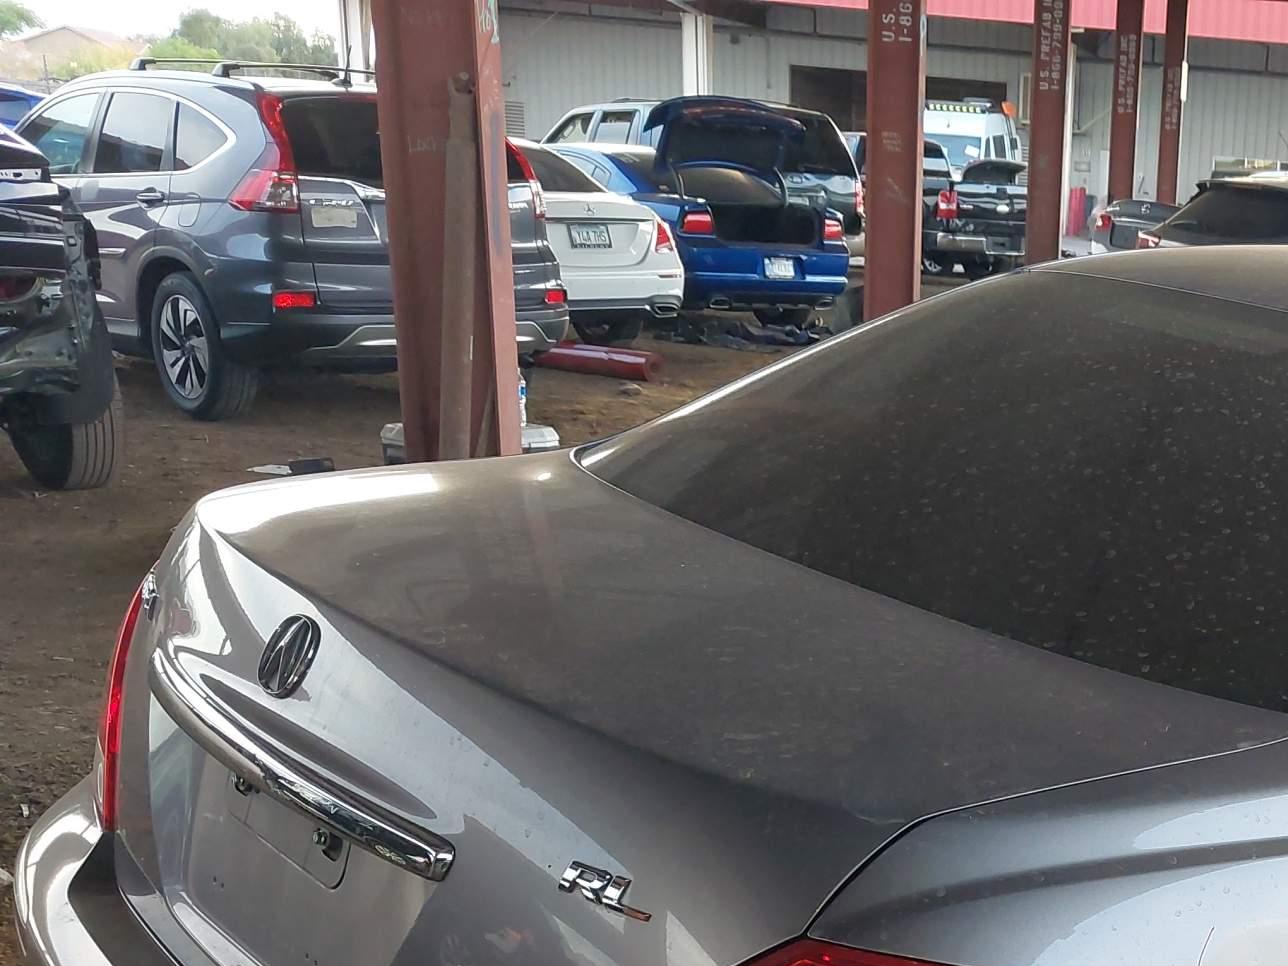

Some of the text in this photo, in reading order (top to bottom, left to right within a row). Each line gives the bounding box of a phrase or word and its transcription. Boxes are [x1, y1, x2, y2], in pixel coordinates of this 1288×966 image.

[881, 8, 896, 42] U.S.
[1041, 11, 1053, 61] PREFAB
[558, 859, 652, 923] RL
